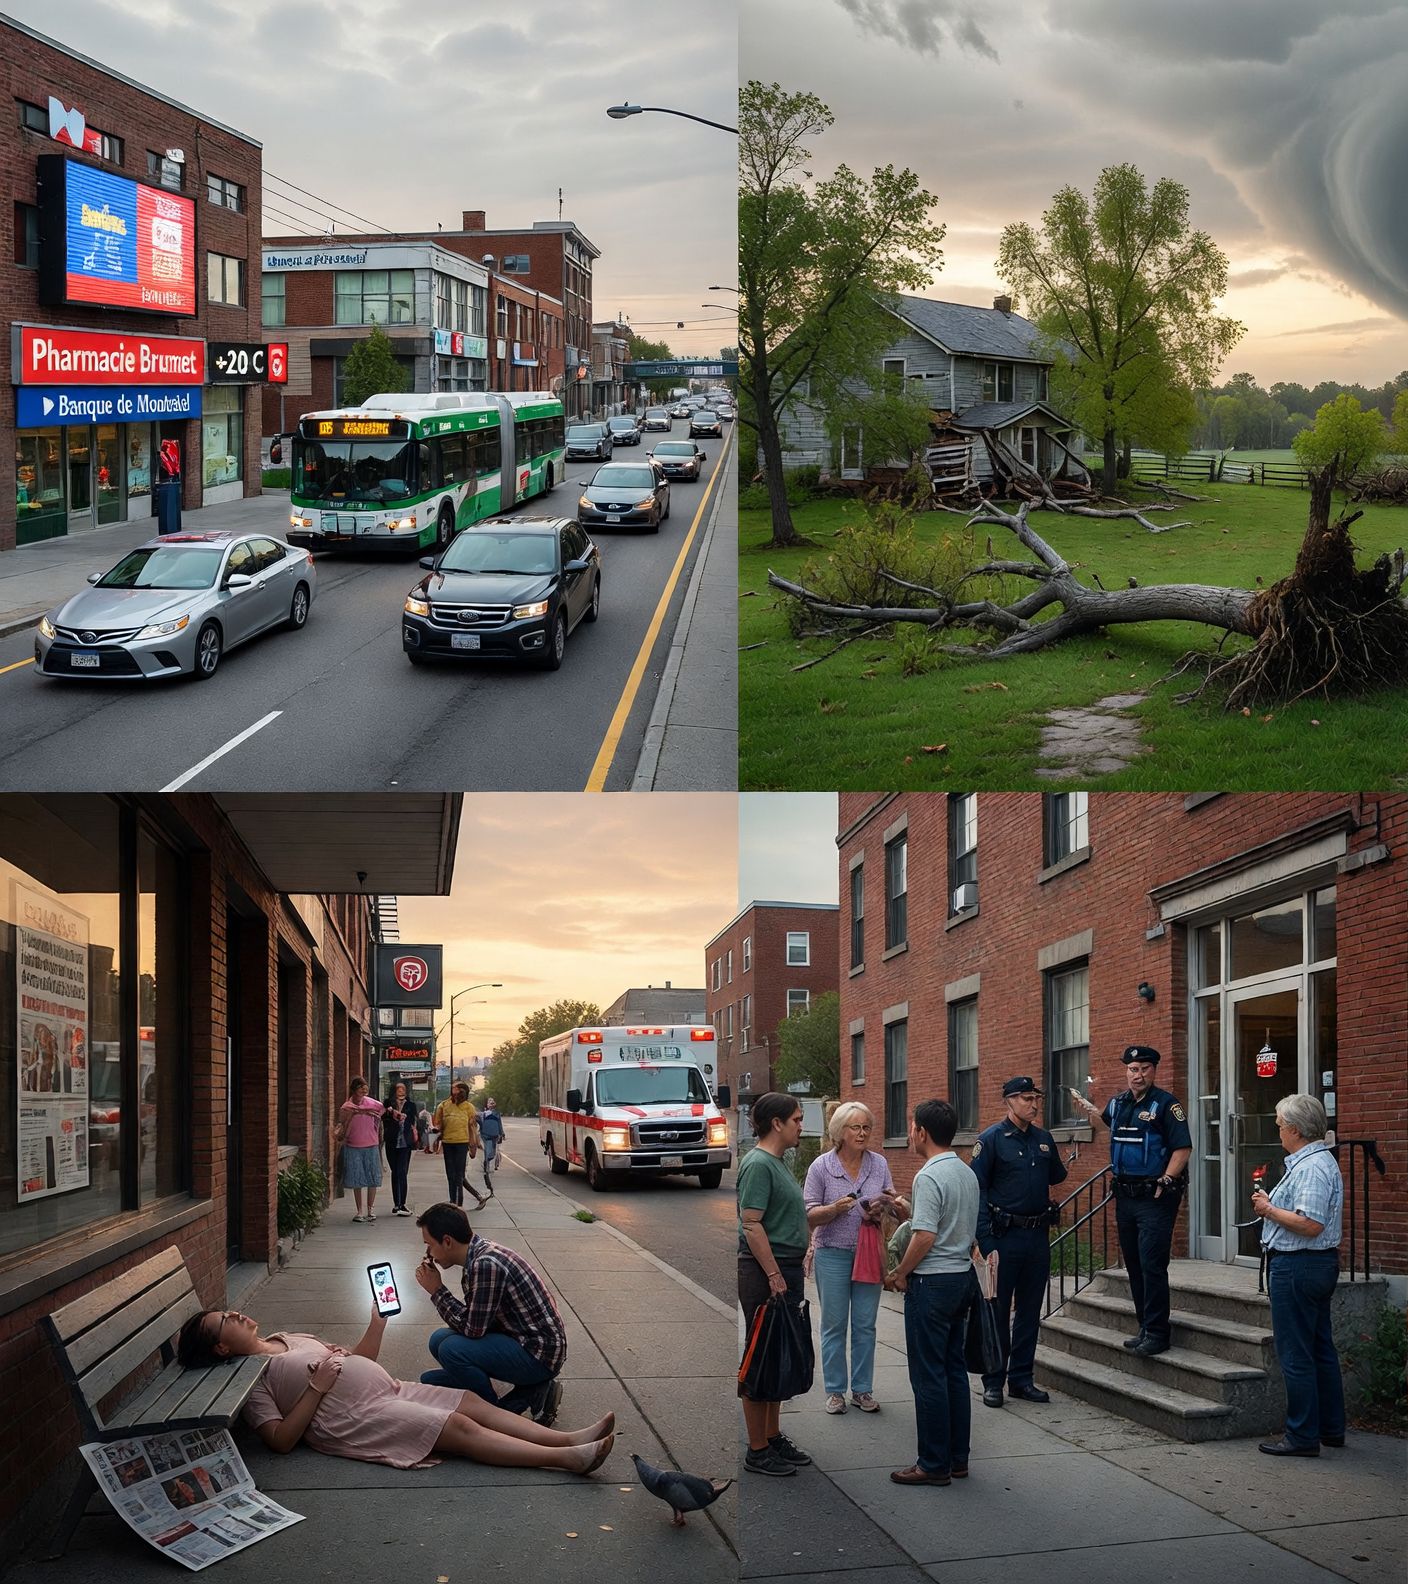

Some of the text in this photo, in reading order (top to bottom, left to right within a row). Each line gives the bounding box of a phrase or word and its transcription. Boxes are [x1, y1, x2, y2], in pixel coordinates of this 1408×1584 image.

[32, 338, 133, 373] Pharmacie
[253, 350, 264, 374] C
[59, 394, 113, 422] Banque
[117, 394, 132, 414] de
